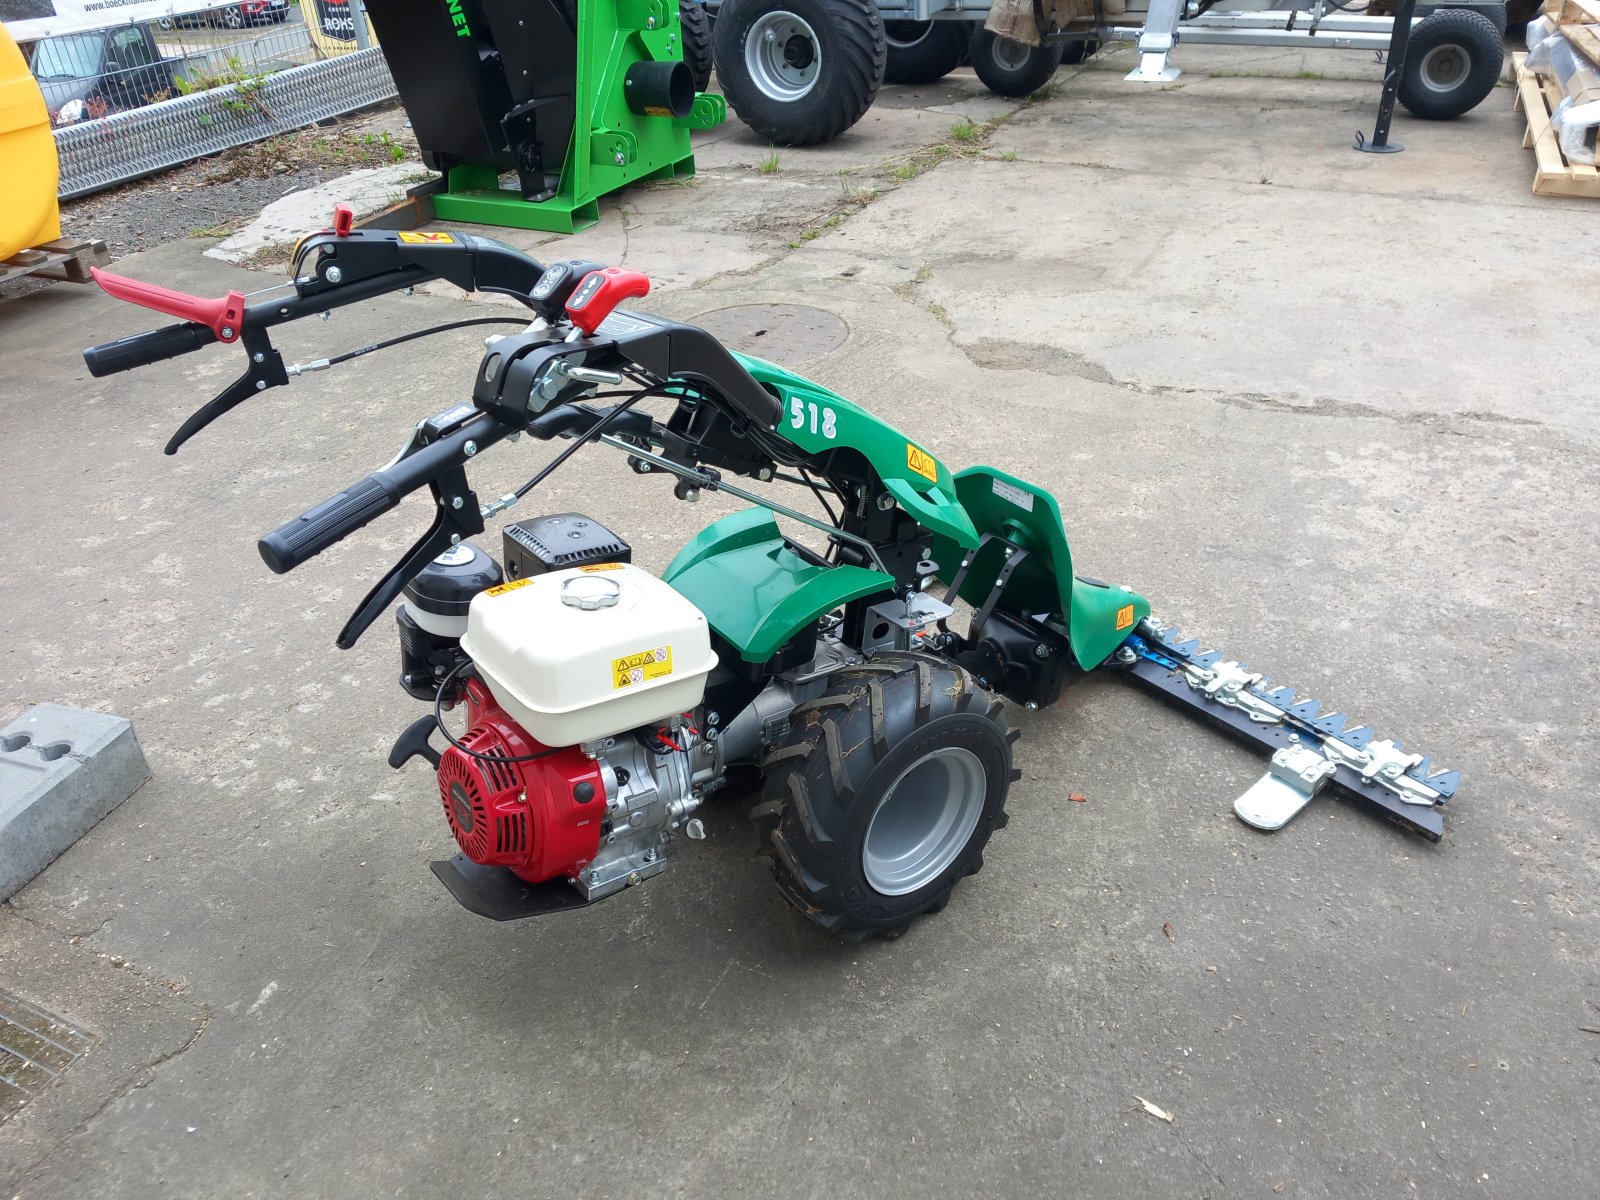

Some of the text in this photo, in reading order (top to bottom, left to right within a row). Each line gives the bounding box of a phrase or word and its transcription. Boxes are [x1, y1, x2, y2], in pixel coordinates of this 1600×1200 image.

[324, 17, 354, 31] ROHS
[790, 396, 837, 439] 518
[452, 788, 472, 812] HONDA
